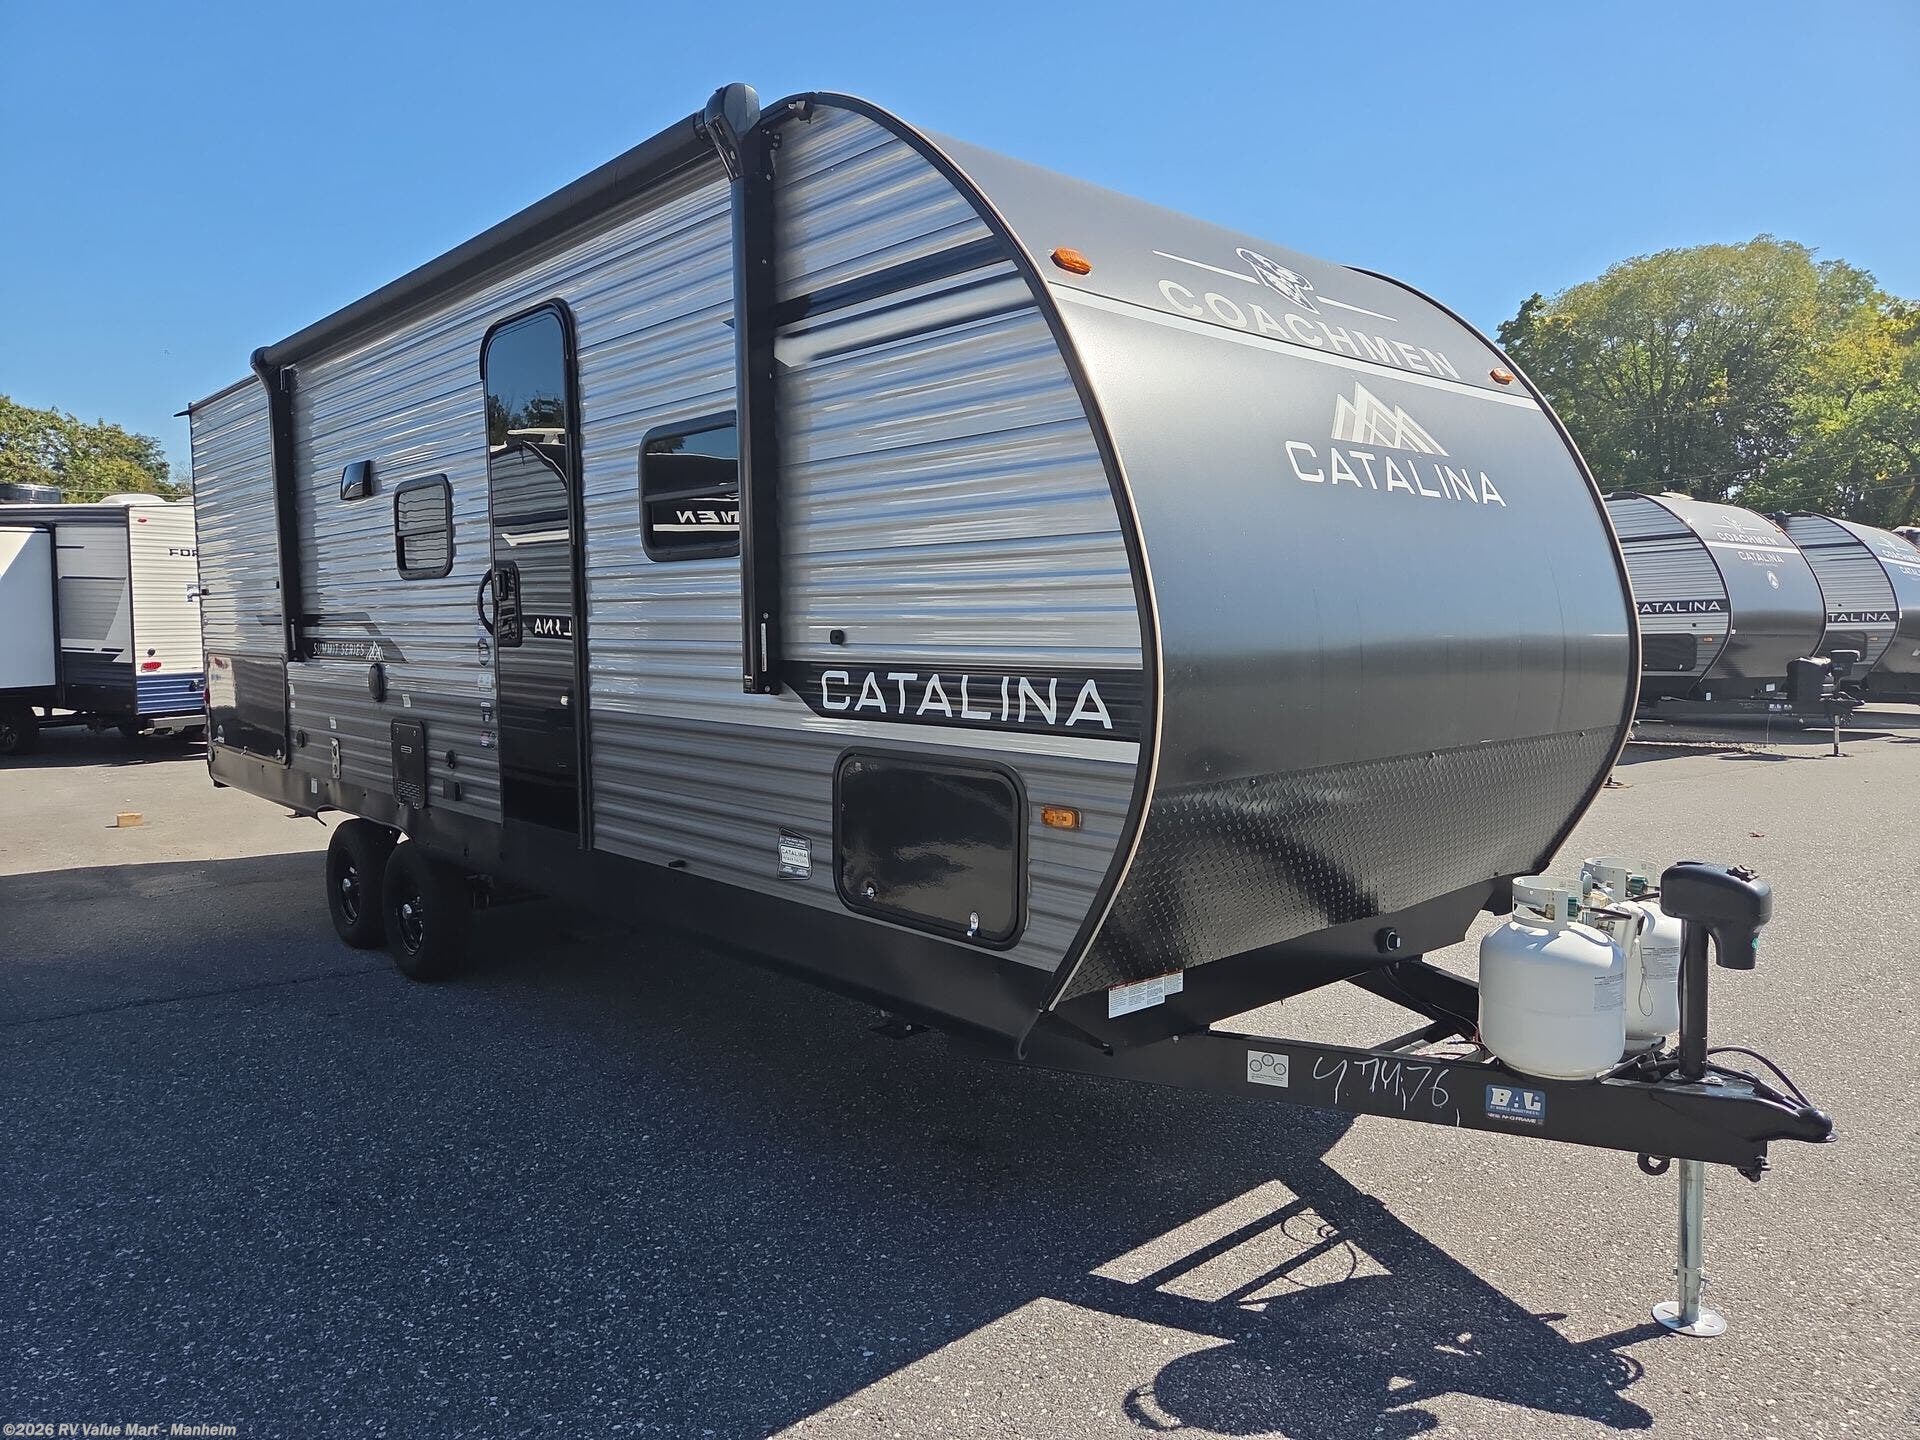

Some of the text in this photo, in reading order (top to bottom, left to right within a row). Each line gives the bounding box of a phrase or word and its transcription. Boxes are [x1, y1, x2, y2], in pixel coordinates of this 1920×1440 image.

[1158, 279, 1461, 379] COACHMEN
[1285, 440, 1507, 507] CATALINA
[1716, 532, 1779, 546] COACHMEN
[1737, 551, 1784, 563] CATALINA
[1828, 612, 1891, 622] TALINA
[313, 642, 365, 656] SUMMIT SERIES
[820, 669, 1113, 730] CATALINA
